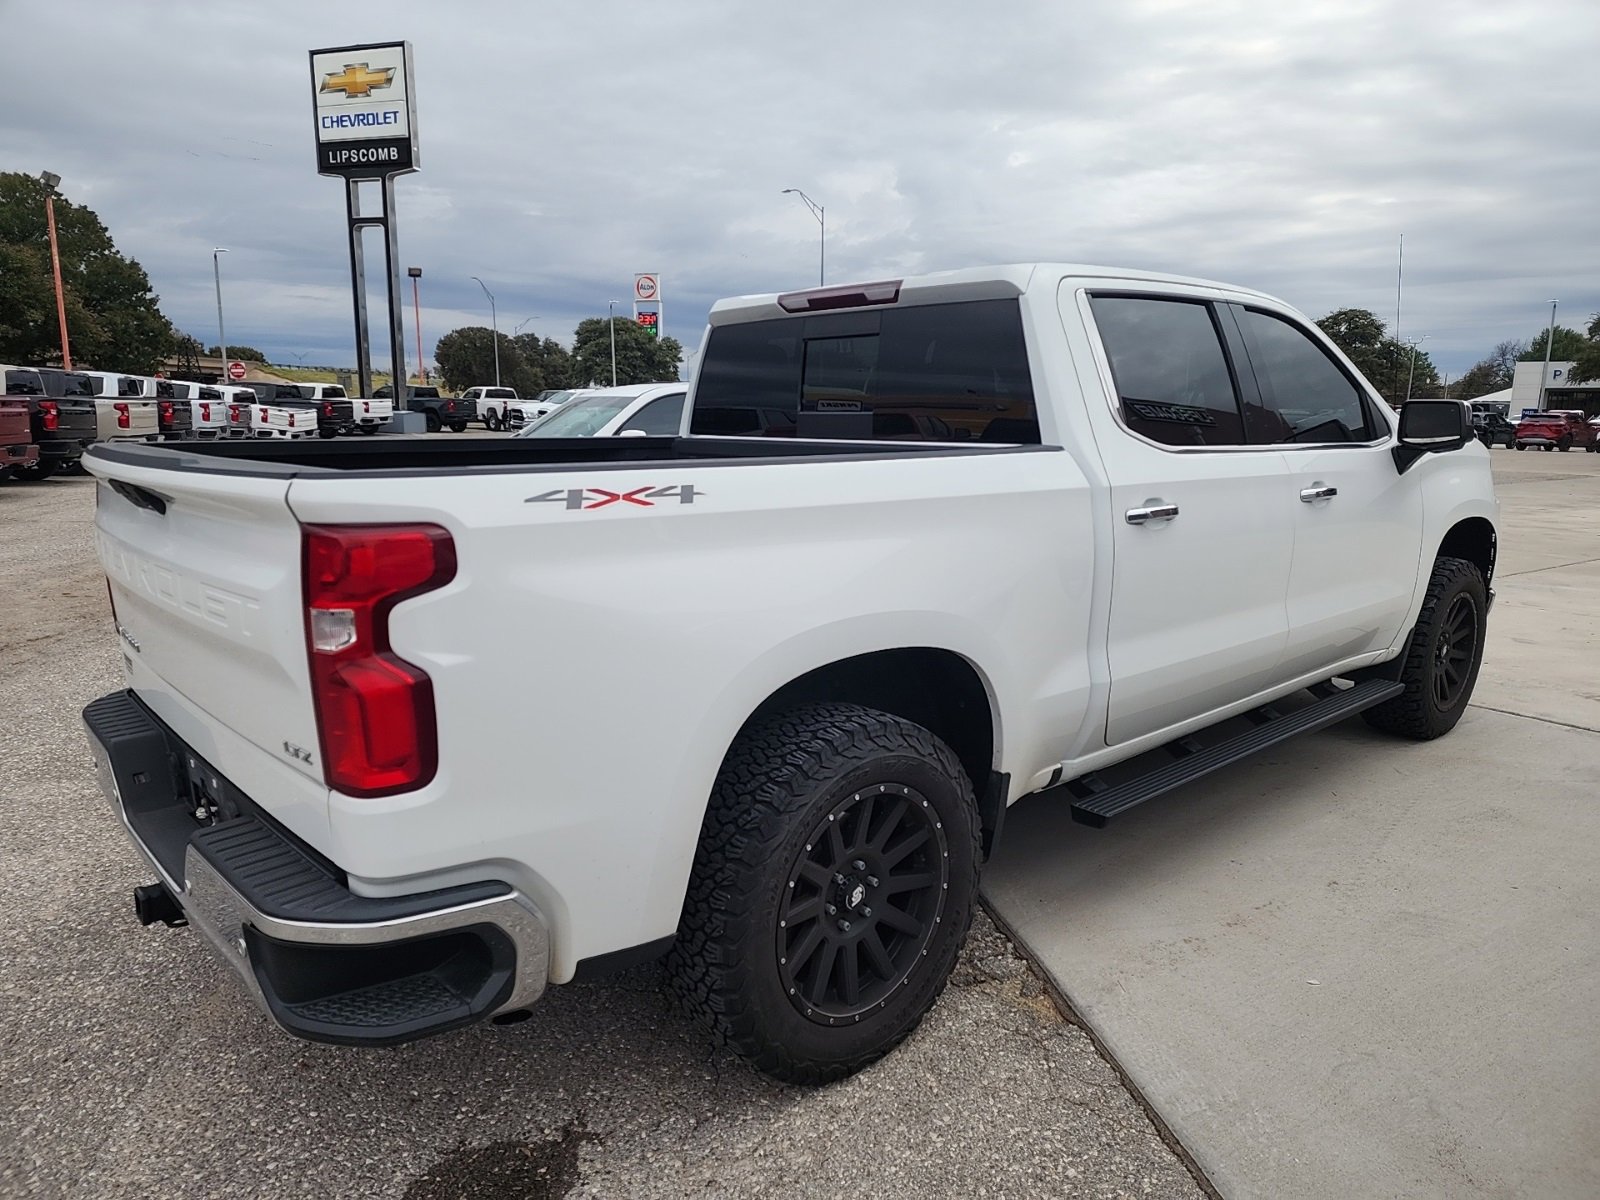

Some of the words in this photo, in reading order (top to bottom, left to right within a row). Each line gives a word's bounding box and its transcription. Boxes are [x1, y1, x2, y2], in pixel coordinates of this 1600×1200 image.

[322, 110, 399, 129] CHEVROLET
[329, 147, 399, 164] LIPSCOMB
[523, 484, 707, 510] 4X4
